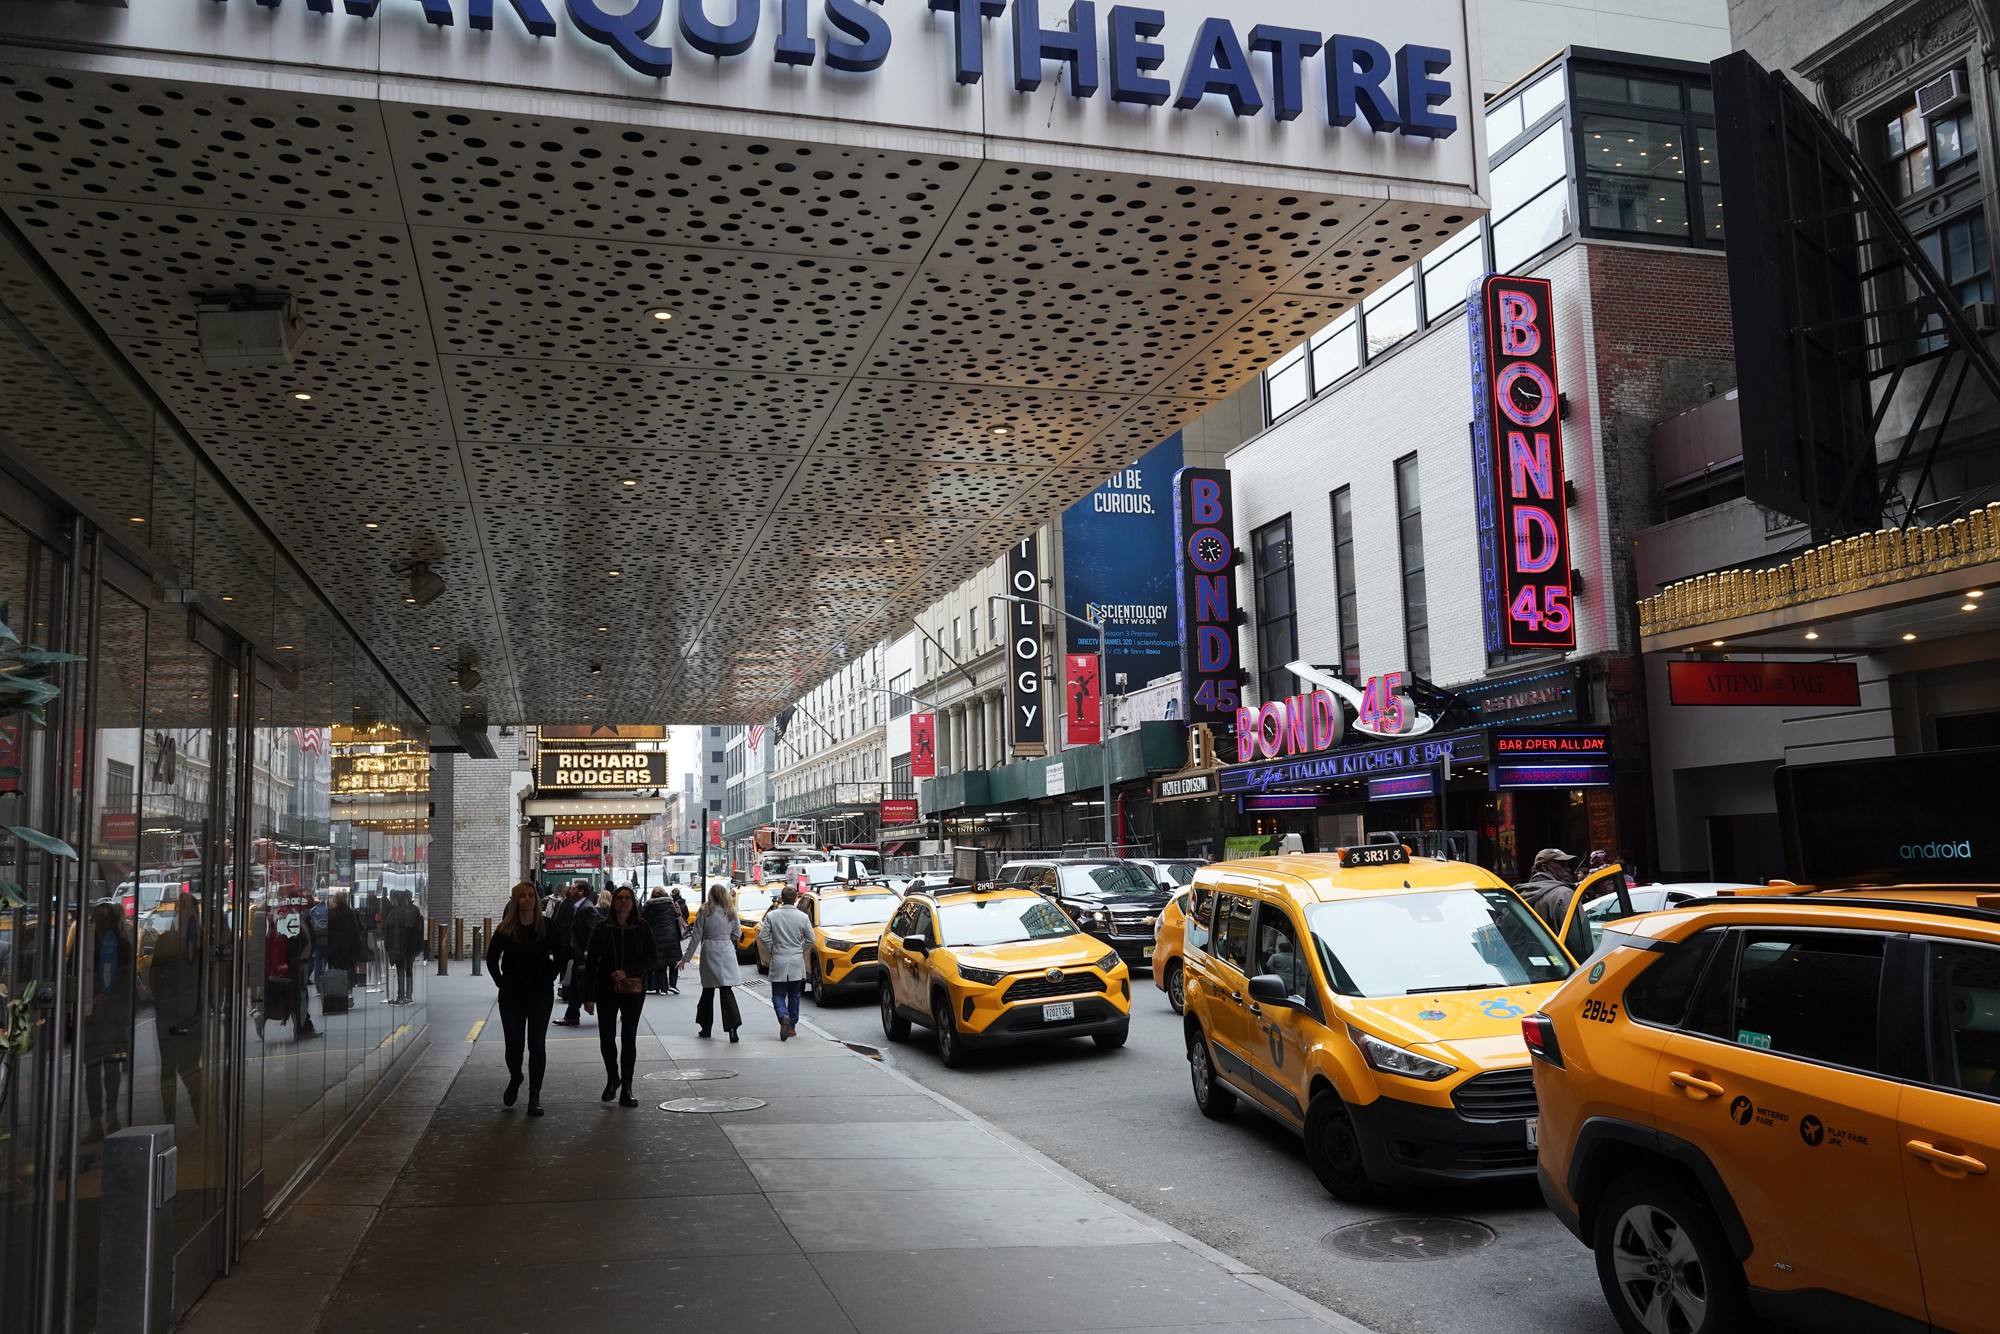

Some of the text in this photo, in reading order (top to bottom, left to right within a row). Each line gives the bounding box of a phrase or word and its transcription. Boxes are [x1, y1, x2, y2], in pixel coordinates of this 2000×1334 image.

[928, 0, 1457, 139] THEATRE
[1496, 288, 1560, 574] BOND
[1126, 470, 1142, 489] BE
[1094, 493, 1155, 514] CURIOUS.
[1189, 478, 1231, 672] BOND
[1101, 605, 1168, 618] SCIENTOLOGY
[1510, 584, 1571, 633] 45
[1705, 674, 1763, 693] ATTEND
[1789, 675, 1826, 693] TALE
[1194, 680, 1239, 713] 45
[1482, 687, 1564, 713] RESTAURANT
[1236, 671, 1405, 763] BOND 45
[1498, 739, 1605, 751] BAR OPEN ALL DAY
[559, 754, 649, 768] RICHARD
[1289, 760, 1337, 780] ITALIAN
[1343, 753, 1402, 774] KITCHEN
[1409, 749, 1418, 764] &
[1424, 743, 1454, 761] BAR
[556, 770, 652, 784] RODGERS
[1162, 776, 1208, 796] HOTEL EDISON
[1364, 849, 1389, 862] 3R31
[1900, 840, 1972, 859] android
[977, 881, 994, 891] 2H90
[1737, 1031, 1771, 1049] curb
[1755, 1116, 1774, 1127] FARE
[1757, 1107, 1789, 1122] METERED
[1827, 1127, 1868, 1145] FLAT FARE
[1827, 1138, 1843, 1147] JFK
